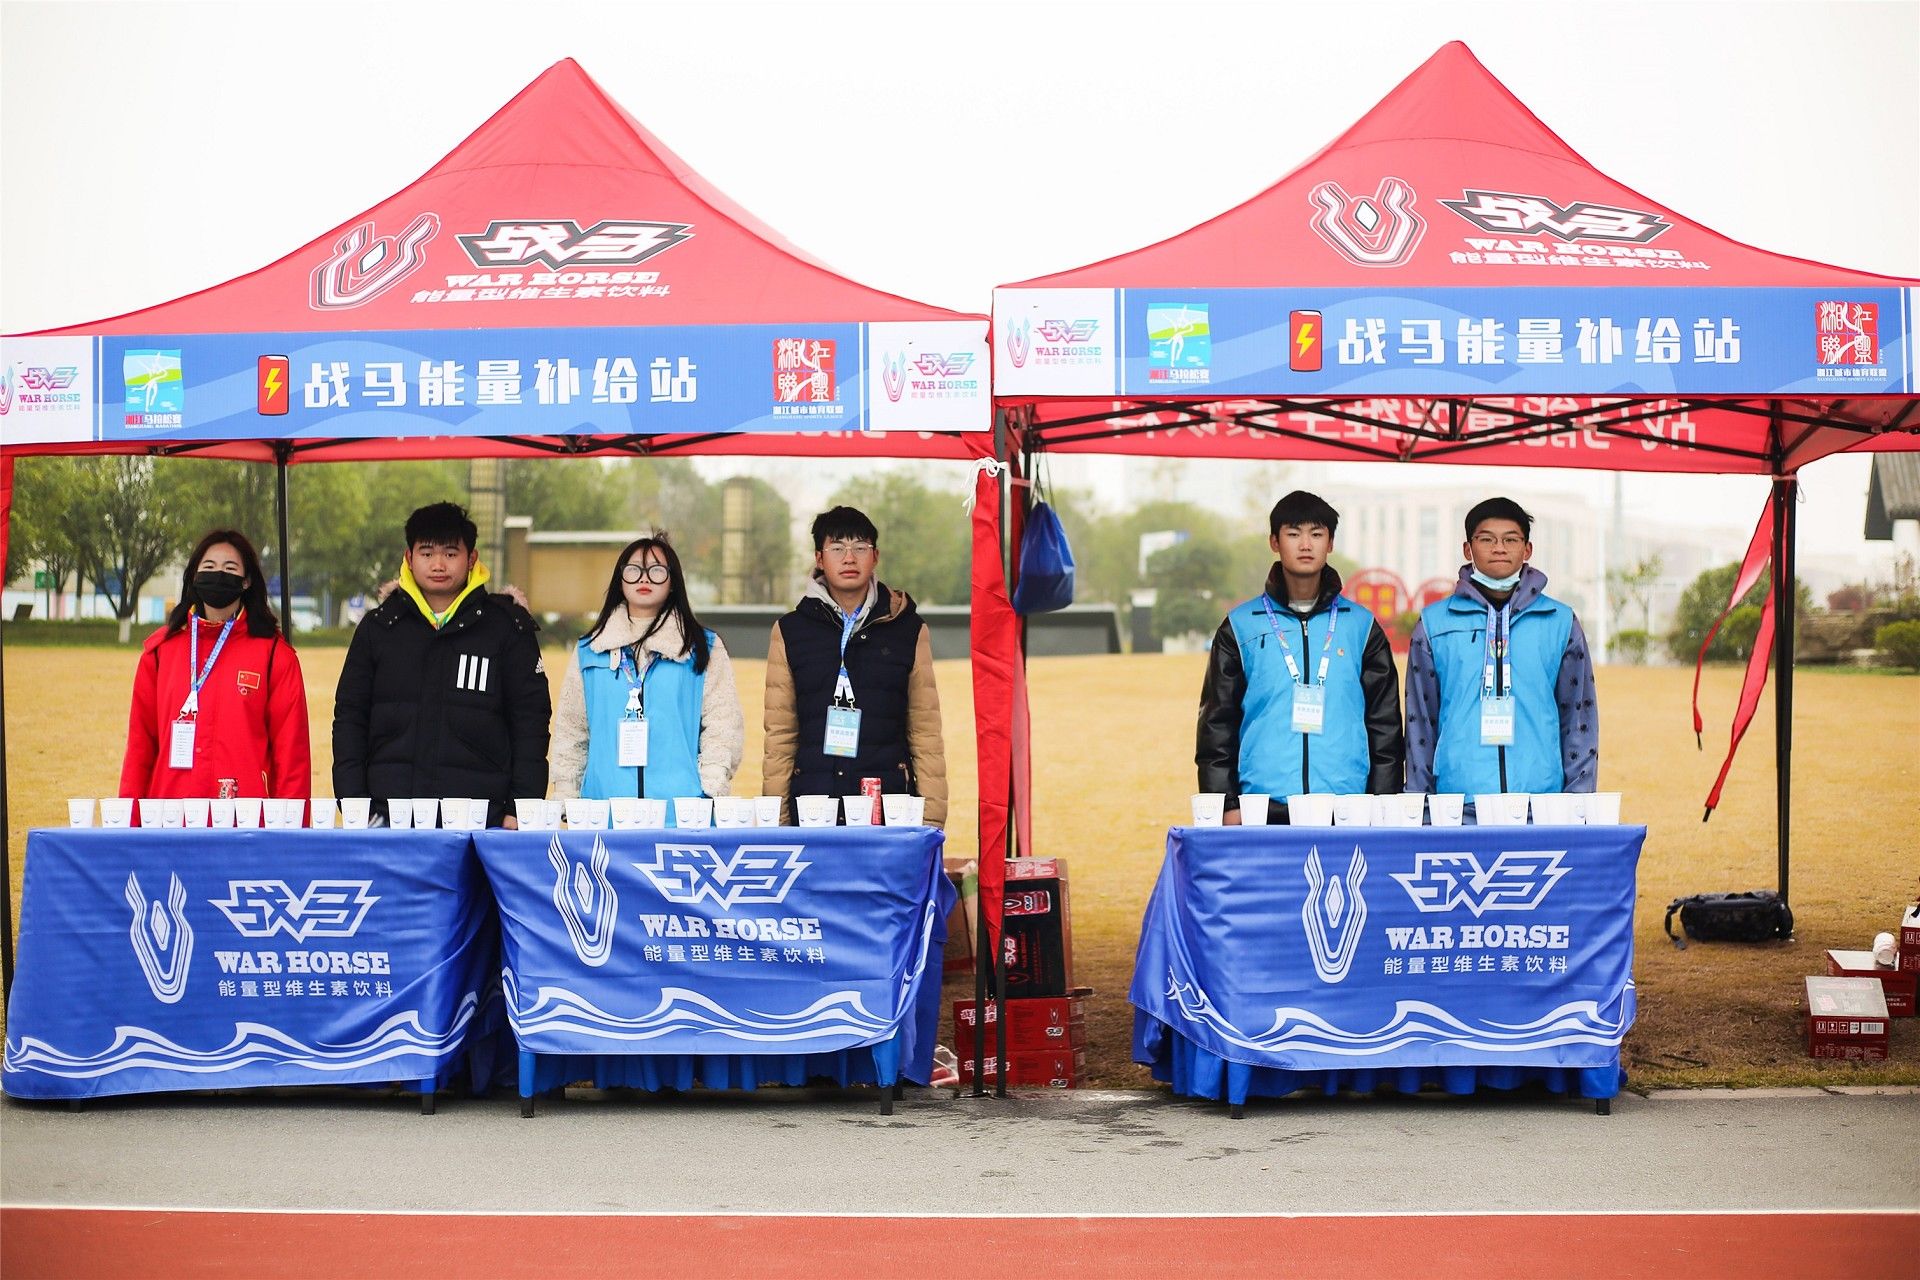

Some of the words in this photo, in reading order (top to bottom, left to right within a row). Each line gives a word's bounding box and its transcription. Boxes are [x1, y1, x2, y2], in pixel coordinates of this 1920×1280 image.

[1464, 238, 1550, 255] WAR
[1552, 242, 1685, 259] HORSE
[1449, 251, 1711, 271] 能量型维生素饮料
[444, 273, 524, 288] WAR
[528, 272, 661, 286] HORSE
[410, 285, 671, 303] 能量型维生素饮料
[1035, 347, 1060, 356] WAR
[1062, 347, 1102, 356] HORSE
[1337, 317, 1742, 365] 战马能量补给站
[304, 356, 698, 408] 战马能量补给站
[911, 381, 936, 390] WAR
[938, 380, 978, 389] HORSE
[19, 394, 42, 403] WAR
[44, 393, 80, 402] HORSE
[632, 843, 813, 911] 战马
[1388, 850, 1574, 919] 战马
[207, 879, 382, 944] 战马
[639, 914, 710, 939] WAR
[712, 917, 823, 941] HORSE
[1385, 926, 1455, 950] WAR
[1458, 925, 1570, 949] HORSE
[214, 951, 282, 975] WAR
[286, 951, 391, 975] HORSE
[644, 944, 826, 965] 能量型维生素饮料
[1383, 955, 1568, 976] 能量型维生素饮料
[217, 980, 393, 998] 能量型维生素饮料
